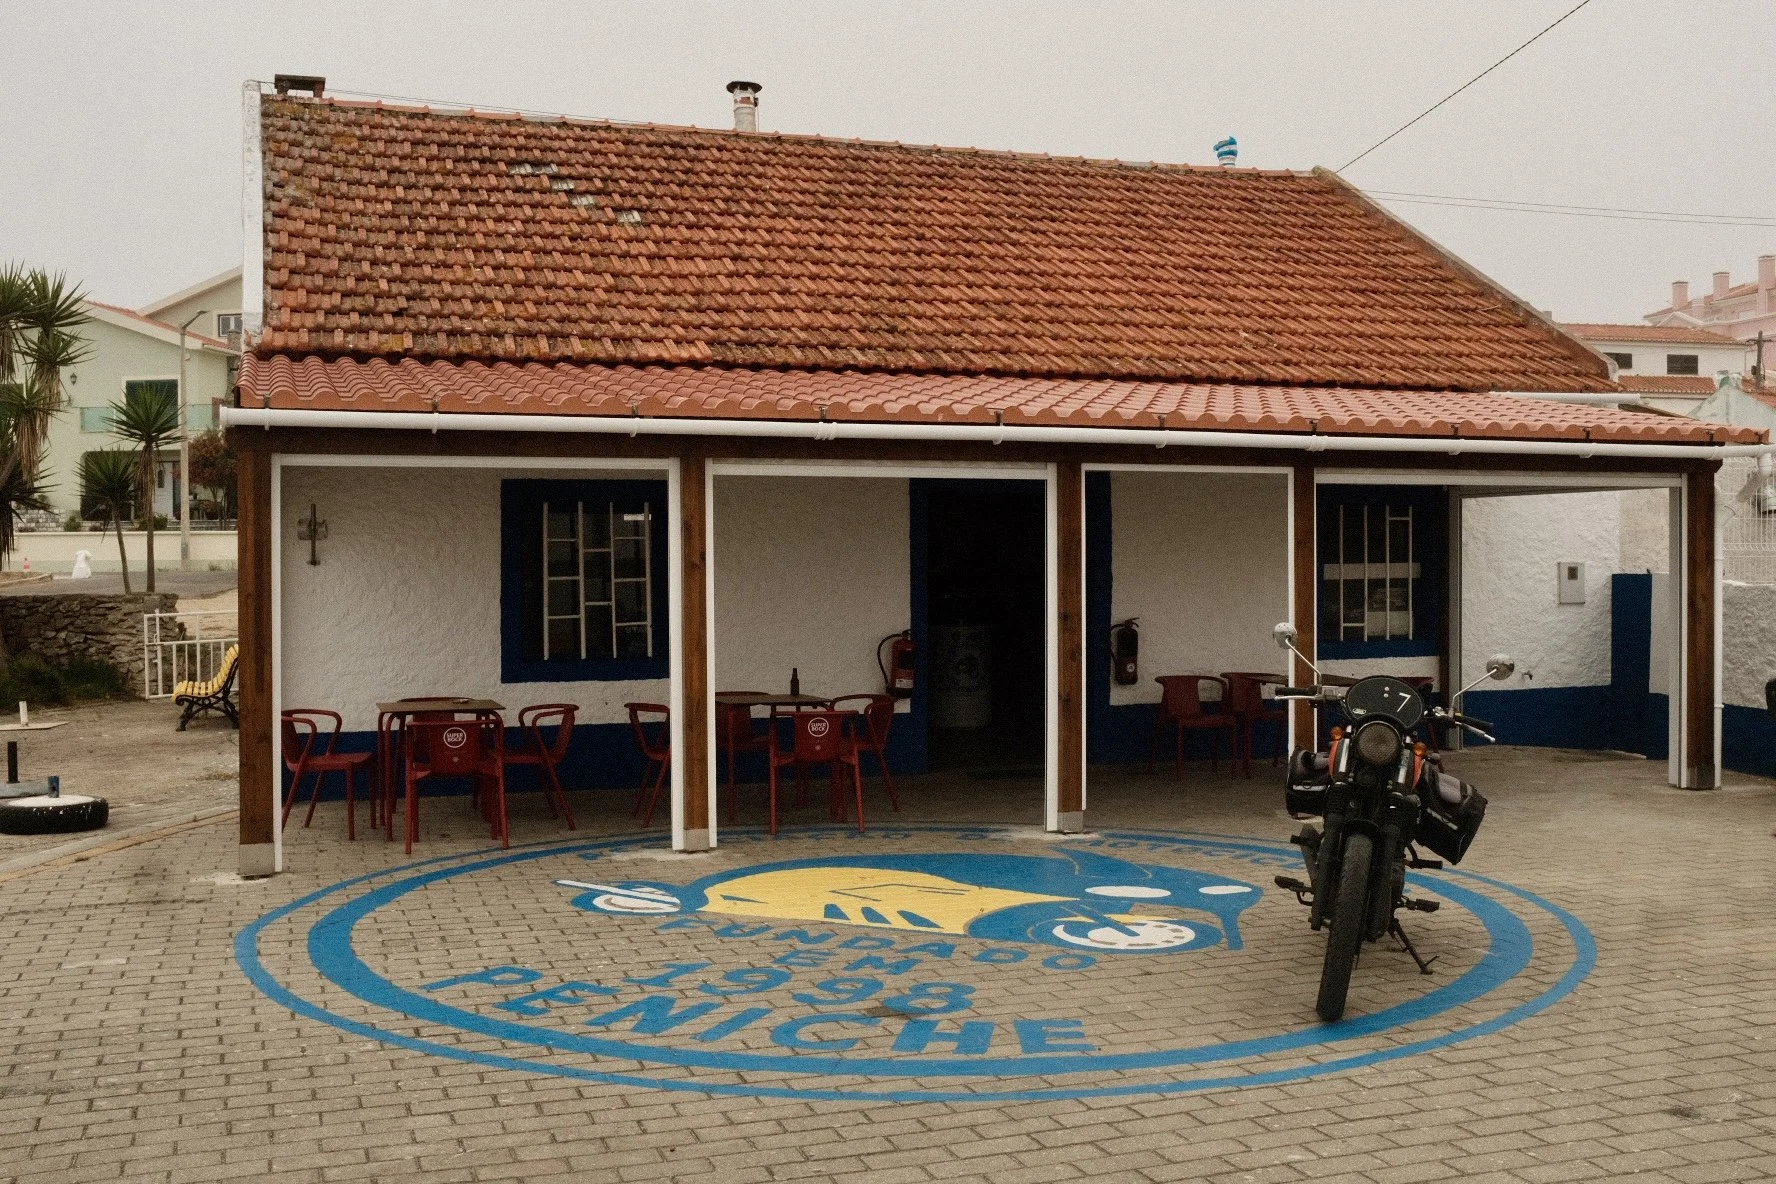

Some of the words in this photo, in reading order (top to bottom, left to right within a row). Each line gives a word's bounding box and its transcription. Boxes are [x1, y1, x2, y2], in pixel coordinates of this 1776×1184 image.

[1397, 692, 1411, 713] 7
[656, 917, 1097, 971] FUNDADO
[772, 948, 922, 975] EM
[418, 965, 1097, 1054] PENICHE
[623, 961, 977, 1015] 1998
